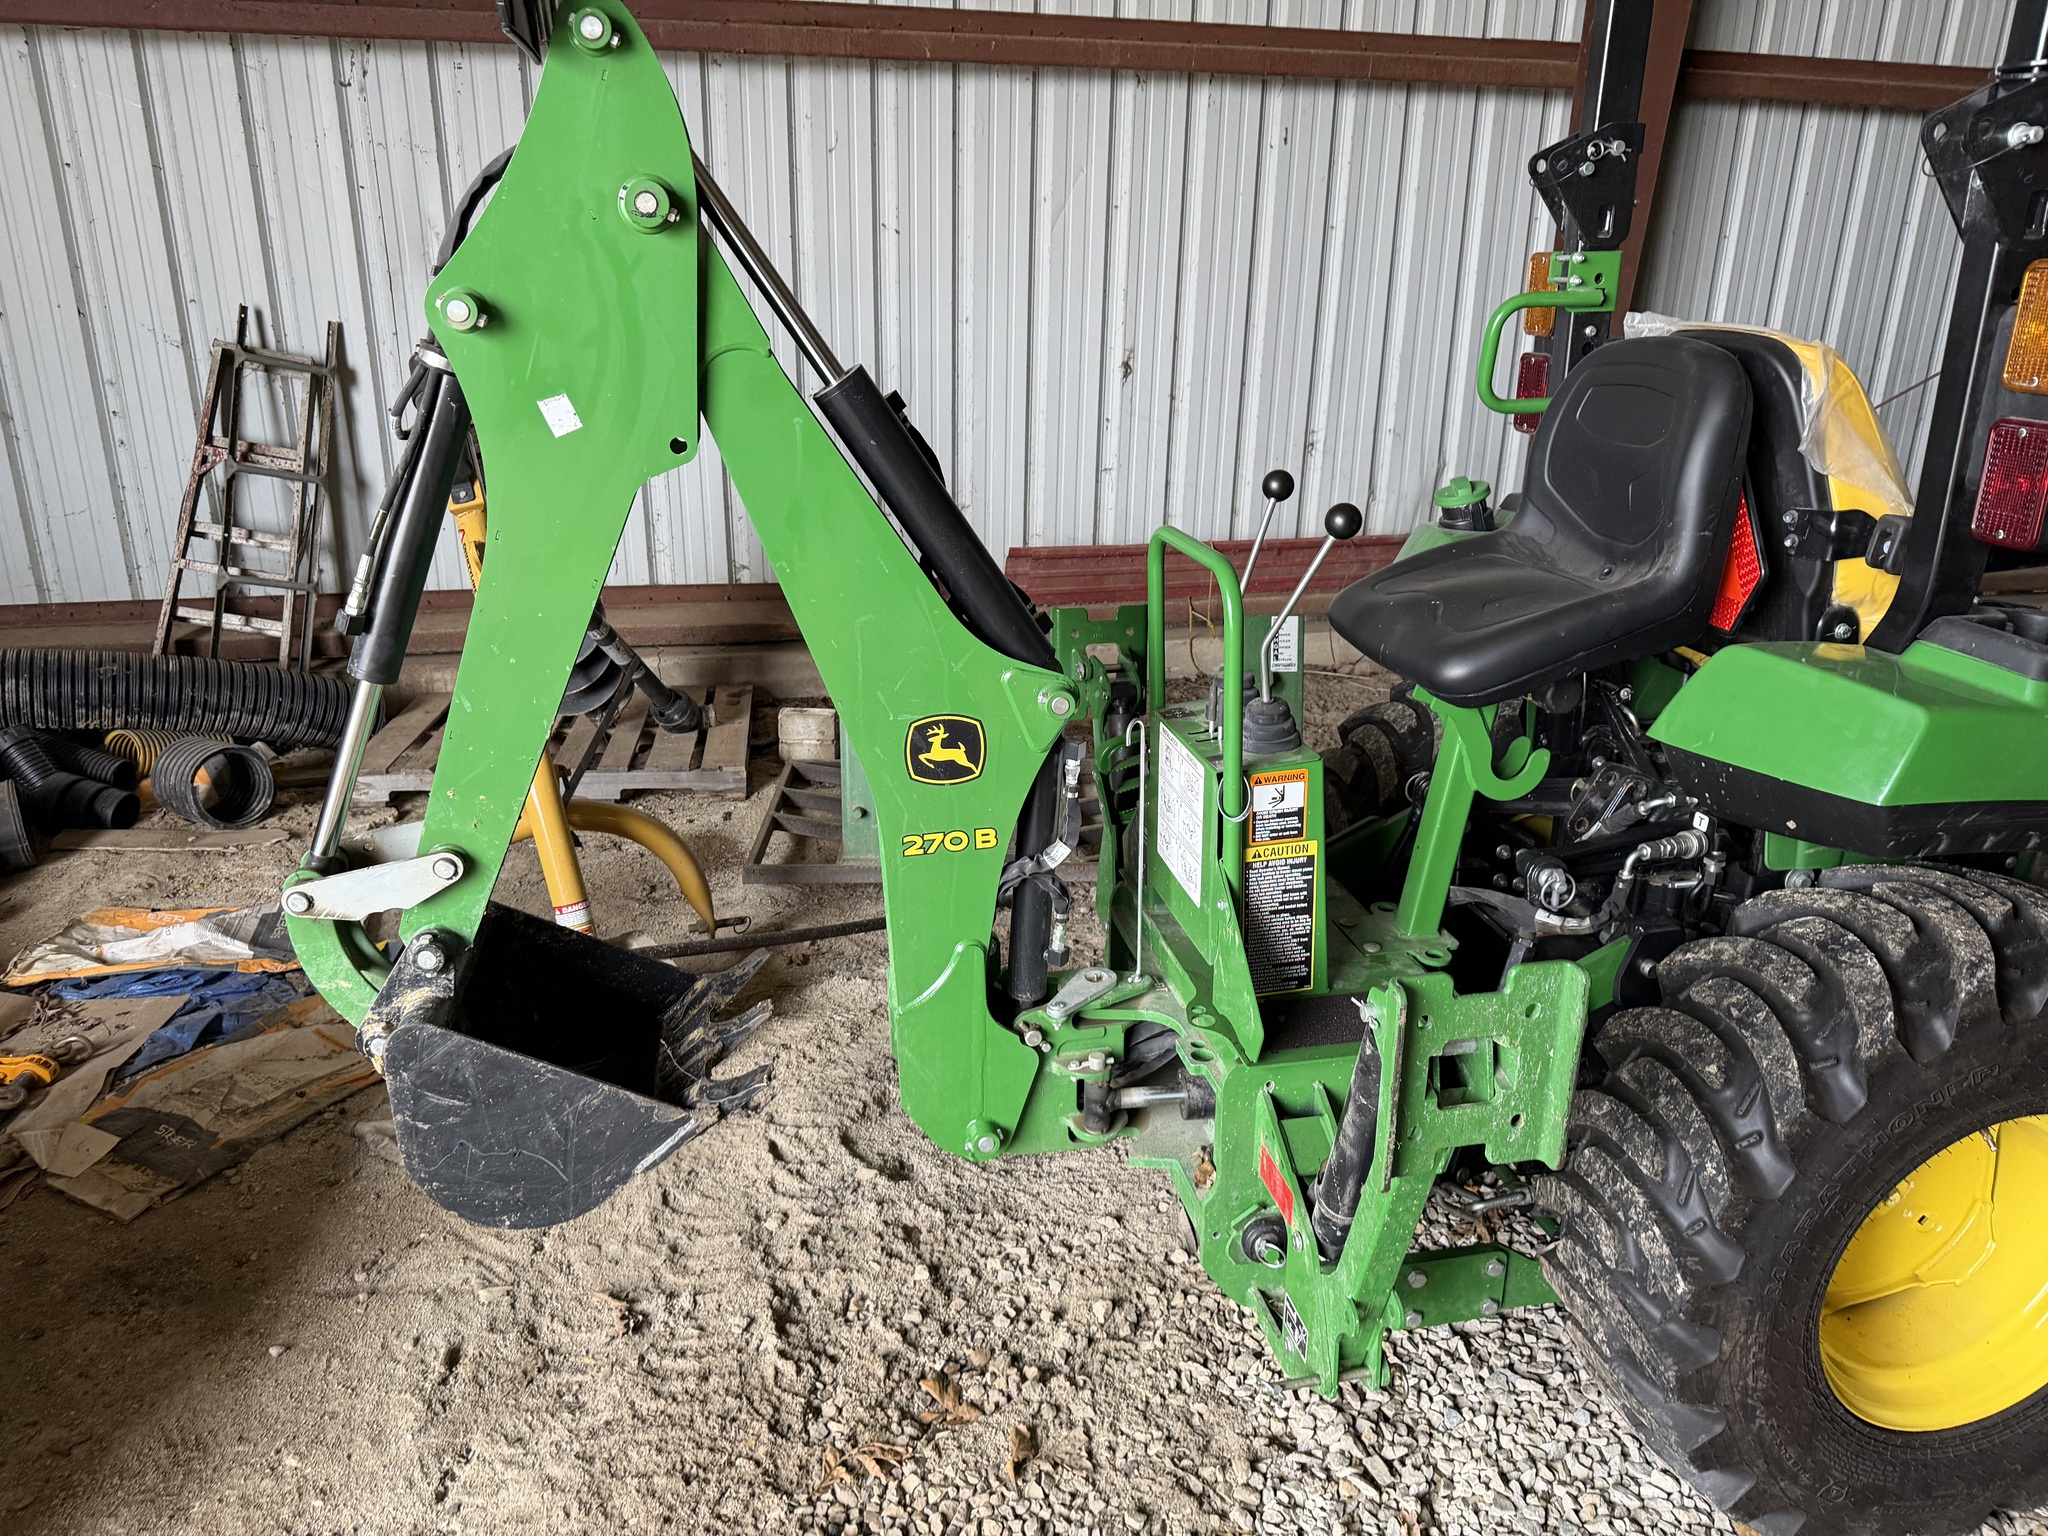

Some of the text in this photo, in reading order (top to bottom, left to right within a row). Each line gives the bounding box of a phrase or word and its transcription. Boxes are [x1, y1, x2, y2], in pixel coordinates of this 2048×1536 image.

[1263, 772, 1306, 783] WARNING
[1698, 815, 1706, 827] T
[901, 827, 998, 858] 270 B
[1263, 843, 1309, 858] CAUTION
[1252, 856, 1308, 869] HELP AVOID INJURY
[1765, 1063, 2001, 1296] MARATHONER
